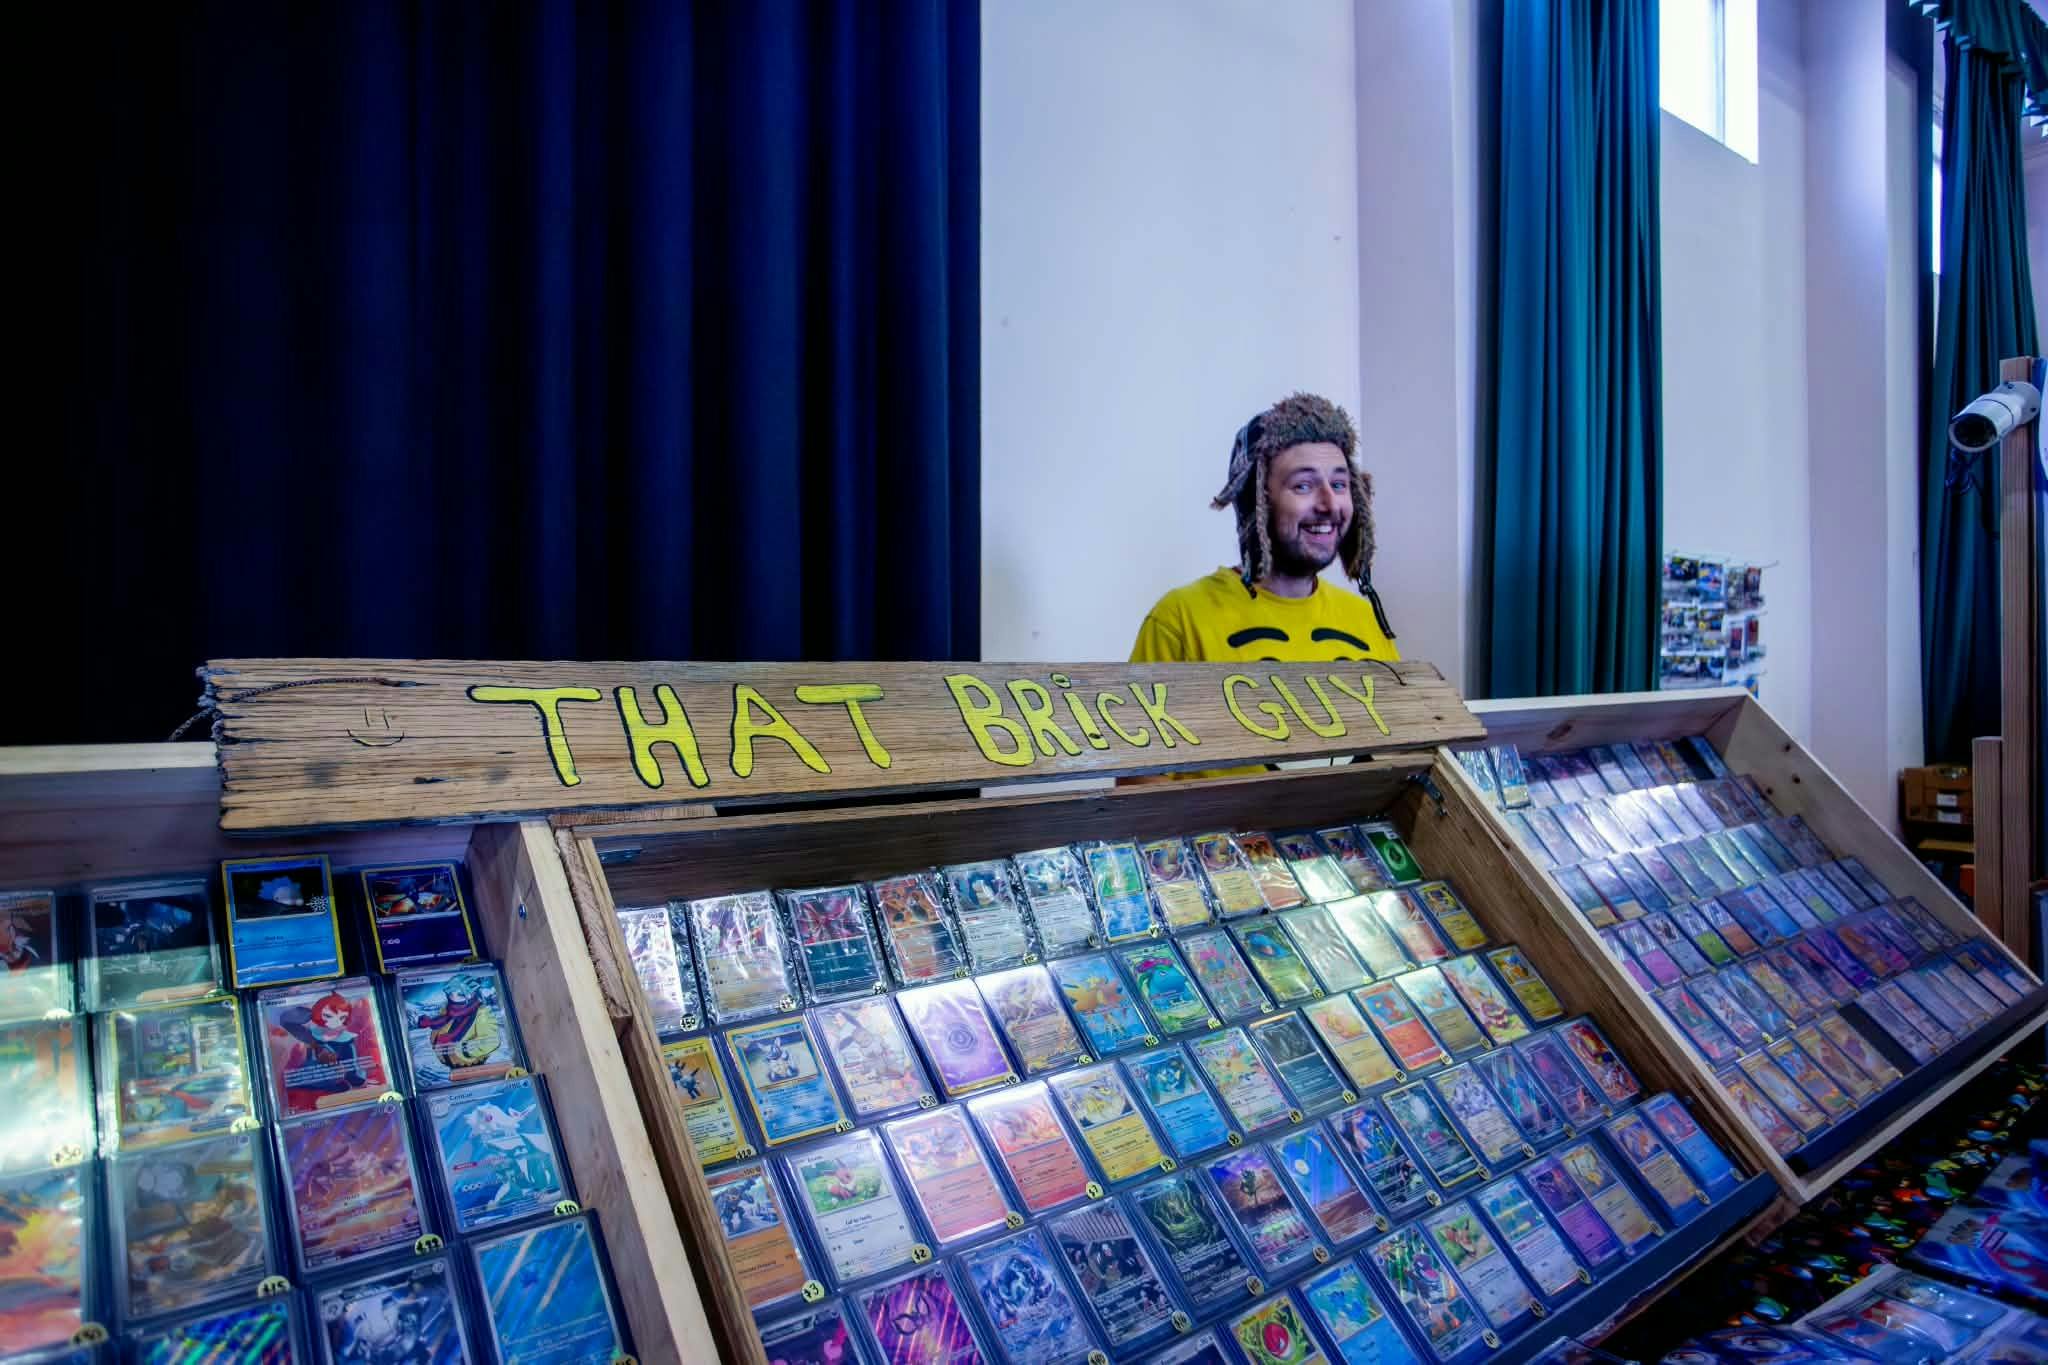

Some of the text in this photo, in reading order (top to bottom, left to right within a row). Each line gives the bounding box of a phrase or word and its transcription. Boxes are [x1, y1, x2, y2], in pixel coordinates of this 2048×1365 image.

[467, 681, 893, 788] THAT
[1222, 673, 1391, 740] GUY
[914, 1248, 927, 1260] £2
[804, 1282, 819, 1298] £3
